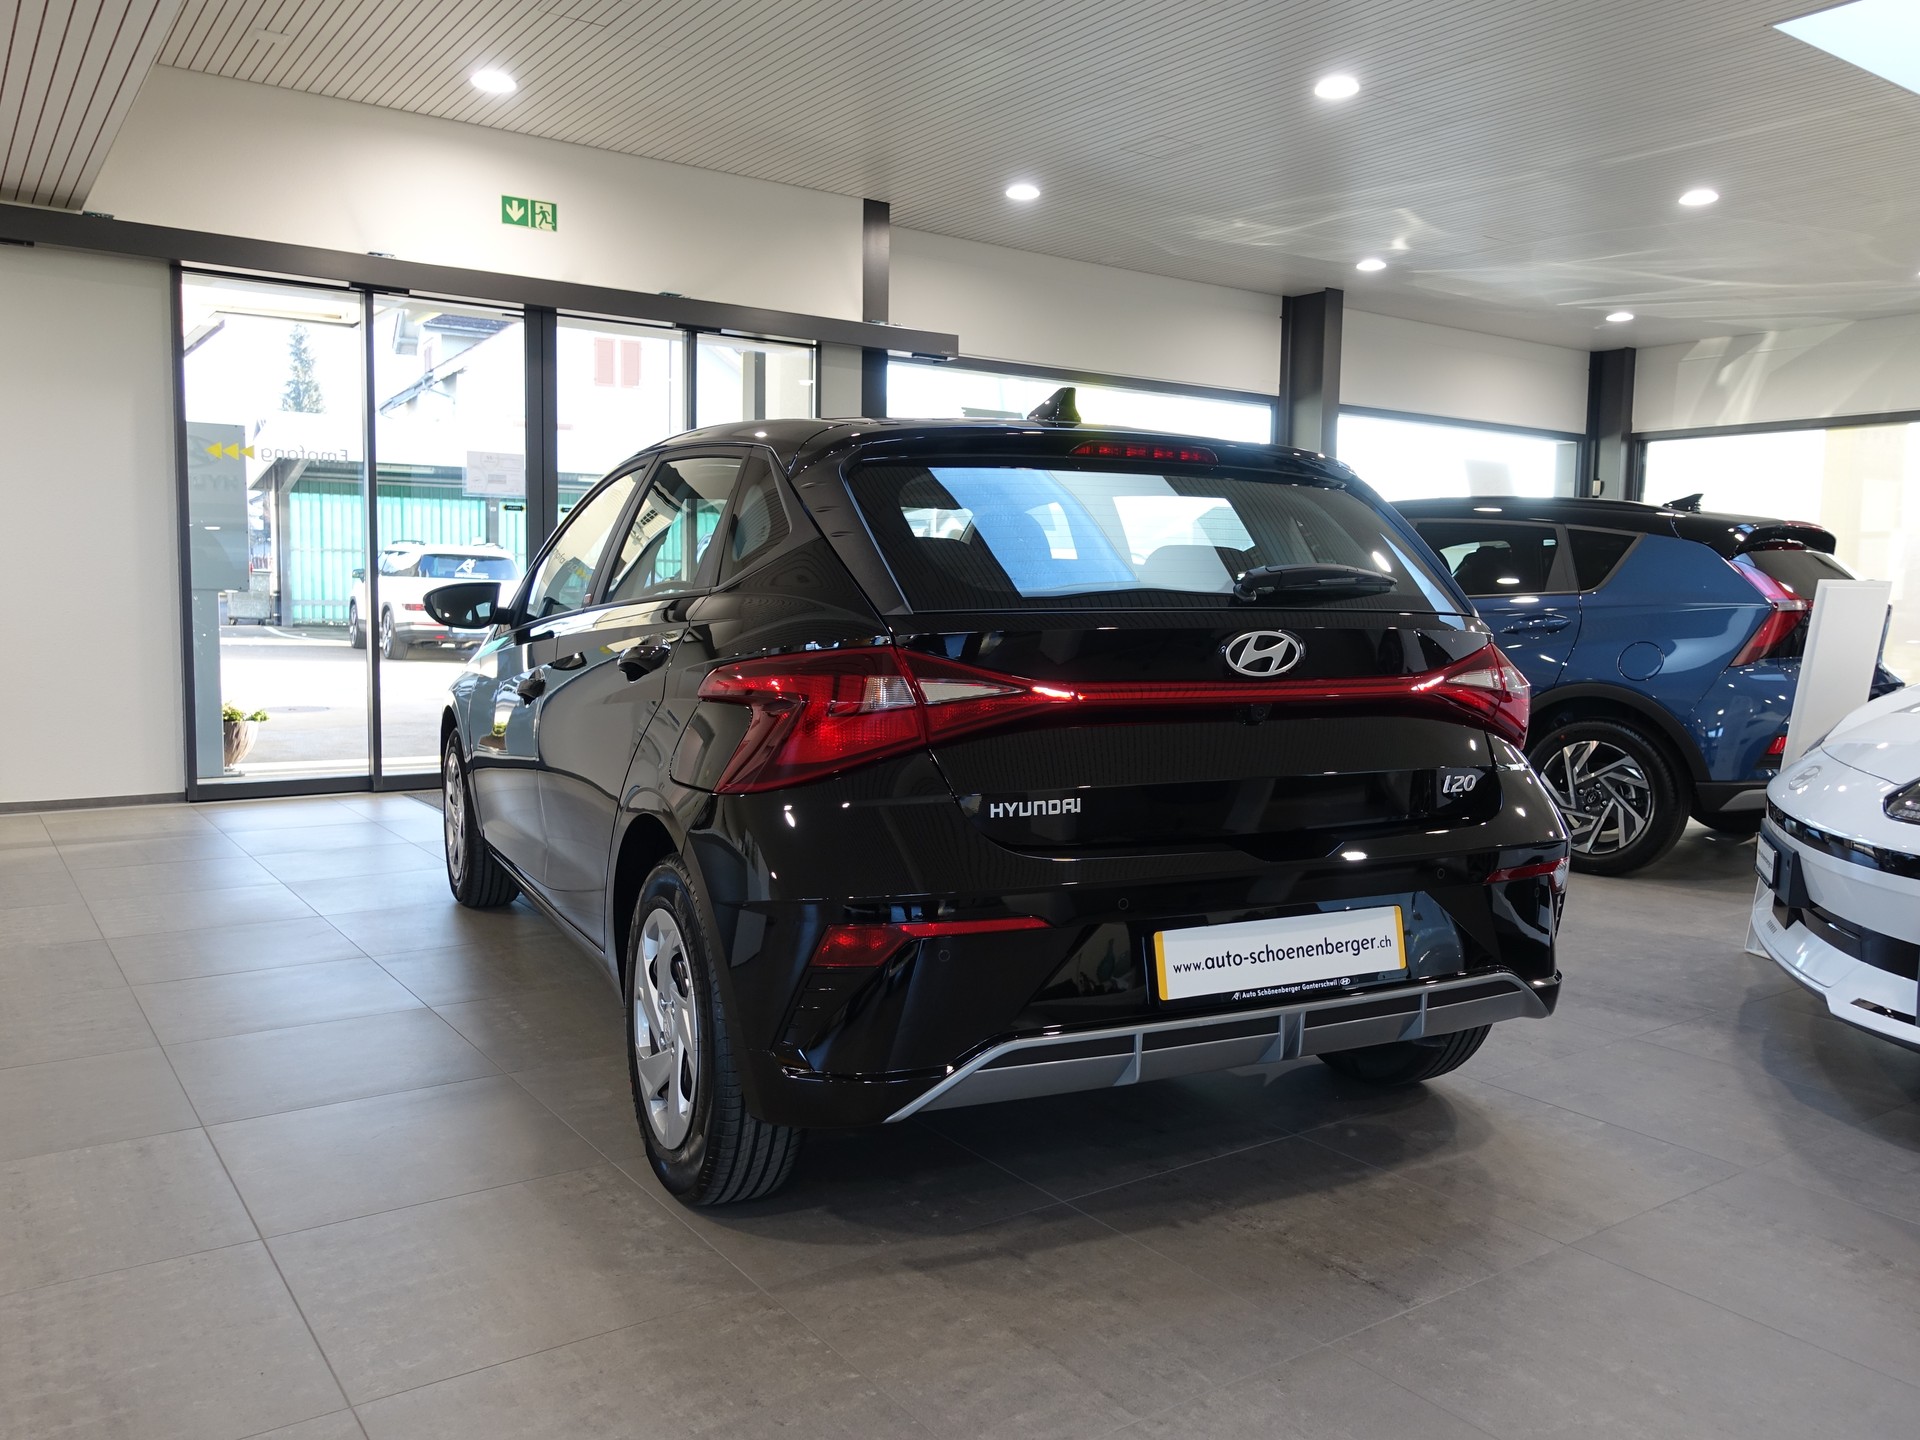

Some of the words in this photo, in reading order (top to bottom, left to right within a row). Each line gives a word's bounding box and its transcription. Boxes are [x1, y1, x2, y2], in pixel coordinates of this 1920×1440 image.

[990, 797, 1081, 818] HYUNDAI
[1172, 935, 1392, 974] www.auto-schoenenberger.ch
[1242, 991, 1257, 999] Auto
[1257, 984, 1301, 997] Schönenberger
[1302, 979, 1338, 990] Ganterschwil
